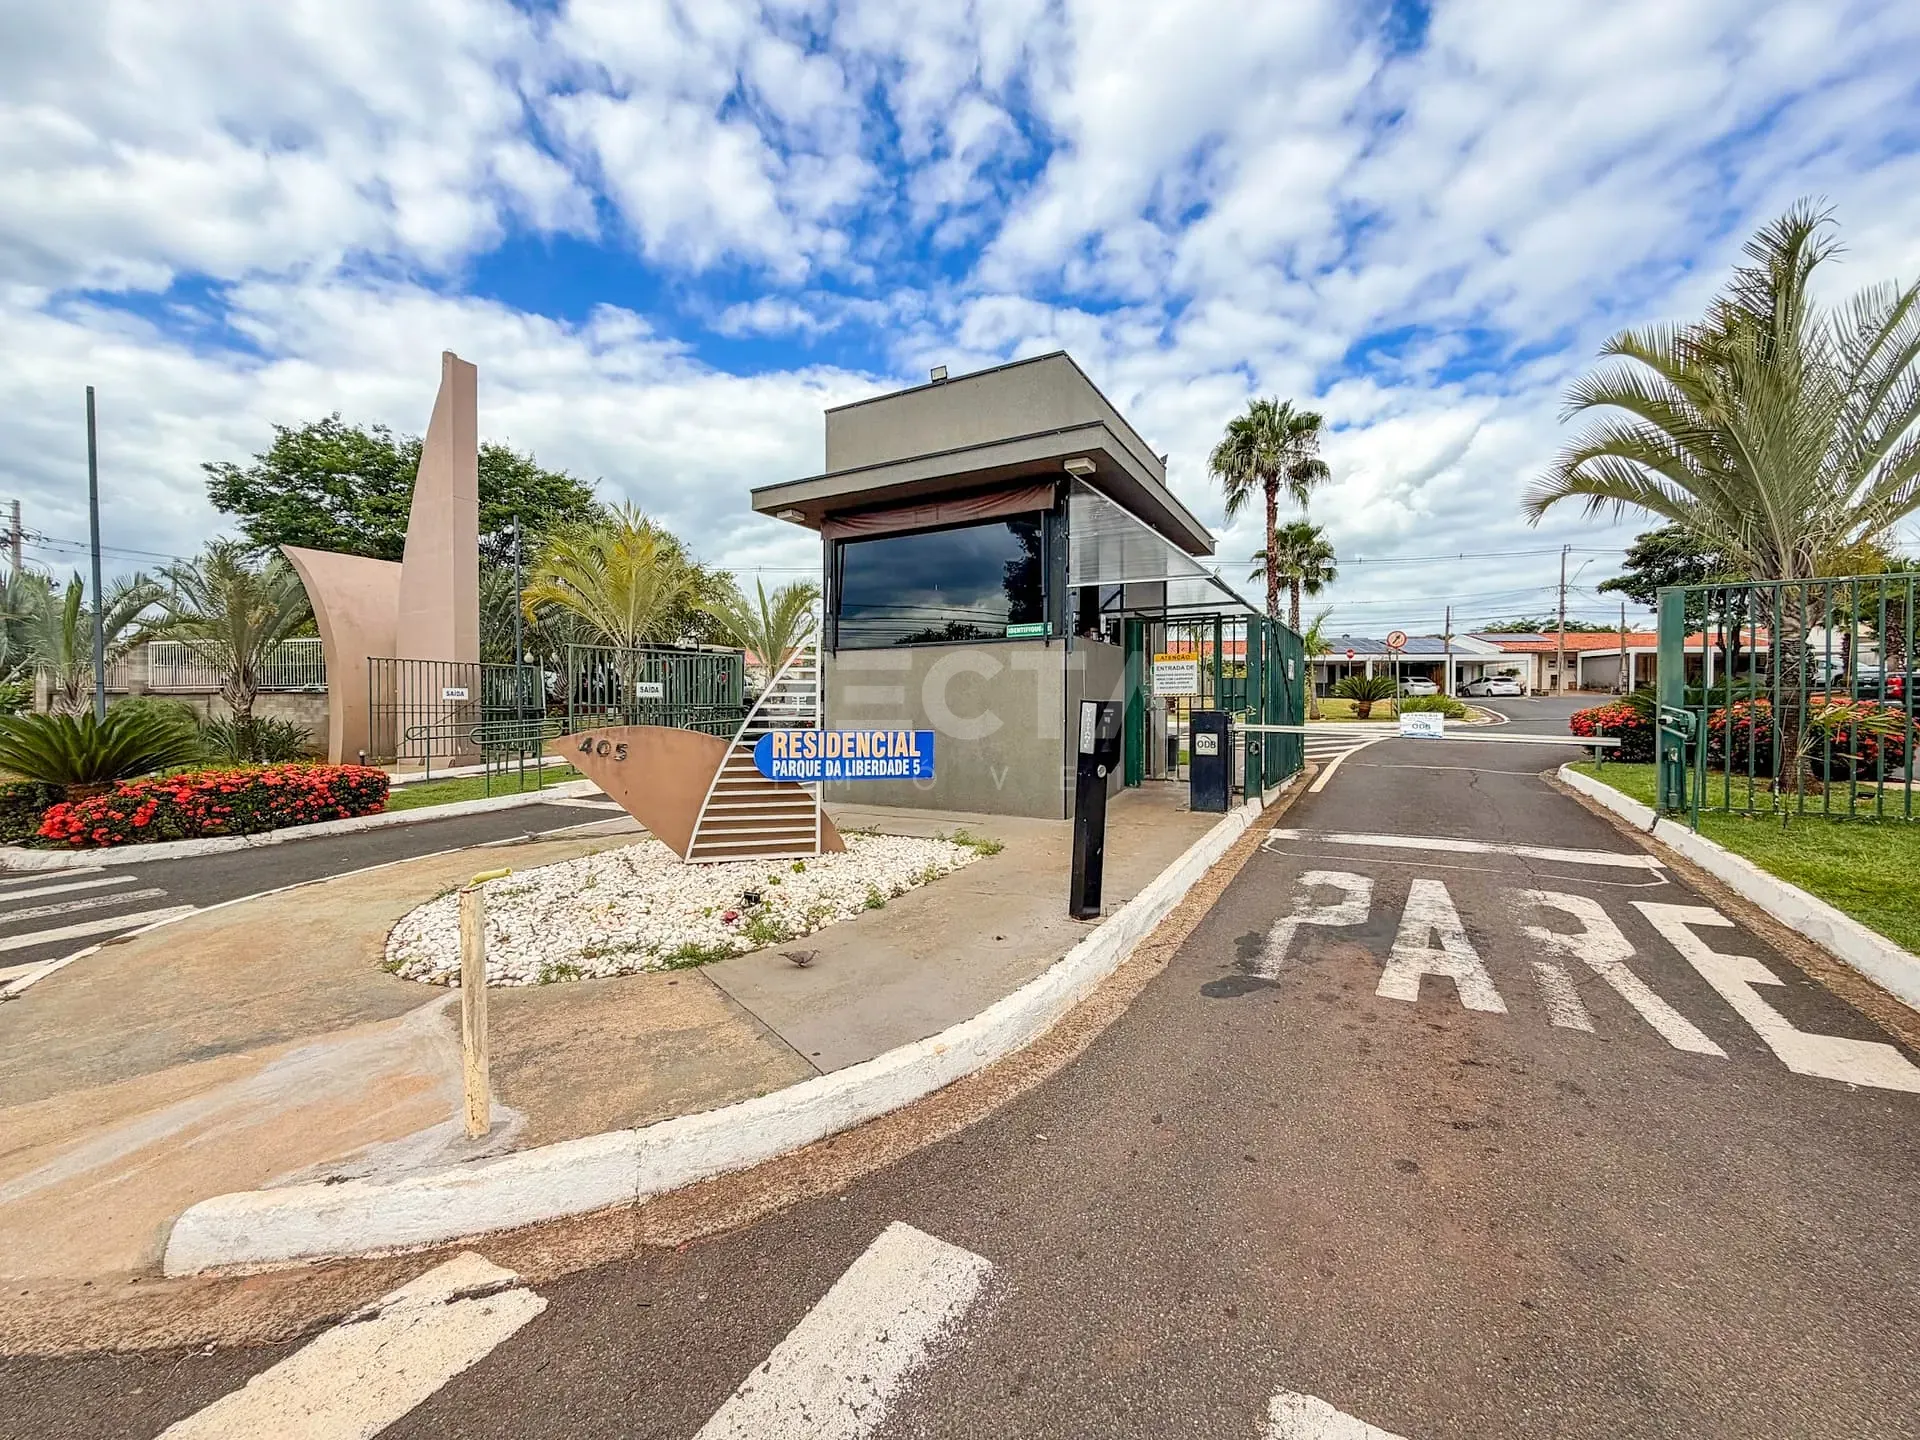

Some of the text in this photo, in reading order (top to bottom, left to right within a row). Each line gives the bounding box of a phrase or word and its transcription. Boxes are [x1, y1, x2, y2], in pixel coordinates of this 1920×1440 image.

[446, 689, 465, 697] SAÍDA
[639, 685, 660, 694] SAÍDA
[578, 737, 629, 761] 405
[772, 732, 921, 759] RESIDENCIAL
[1197, 740, 1216, 748] ODB
[772, 759, 921, 778] PARQUE DA LIBERDADE 5
[1250, 869, 1920, 1093] PARE
